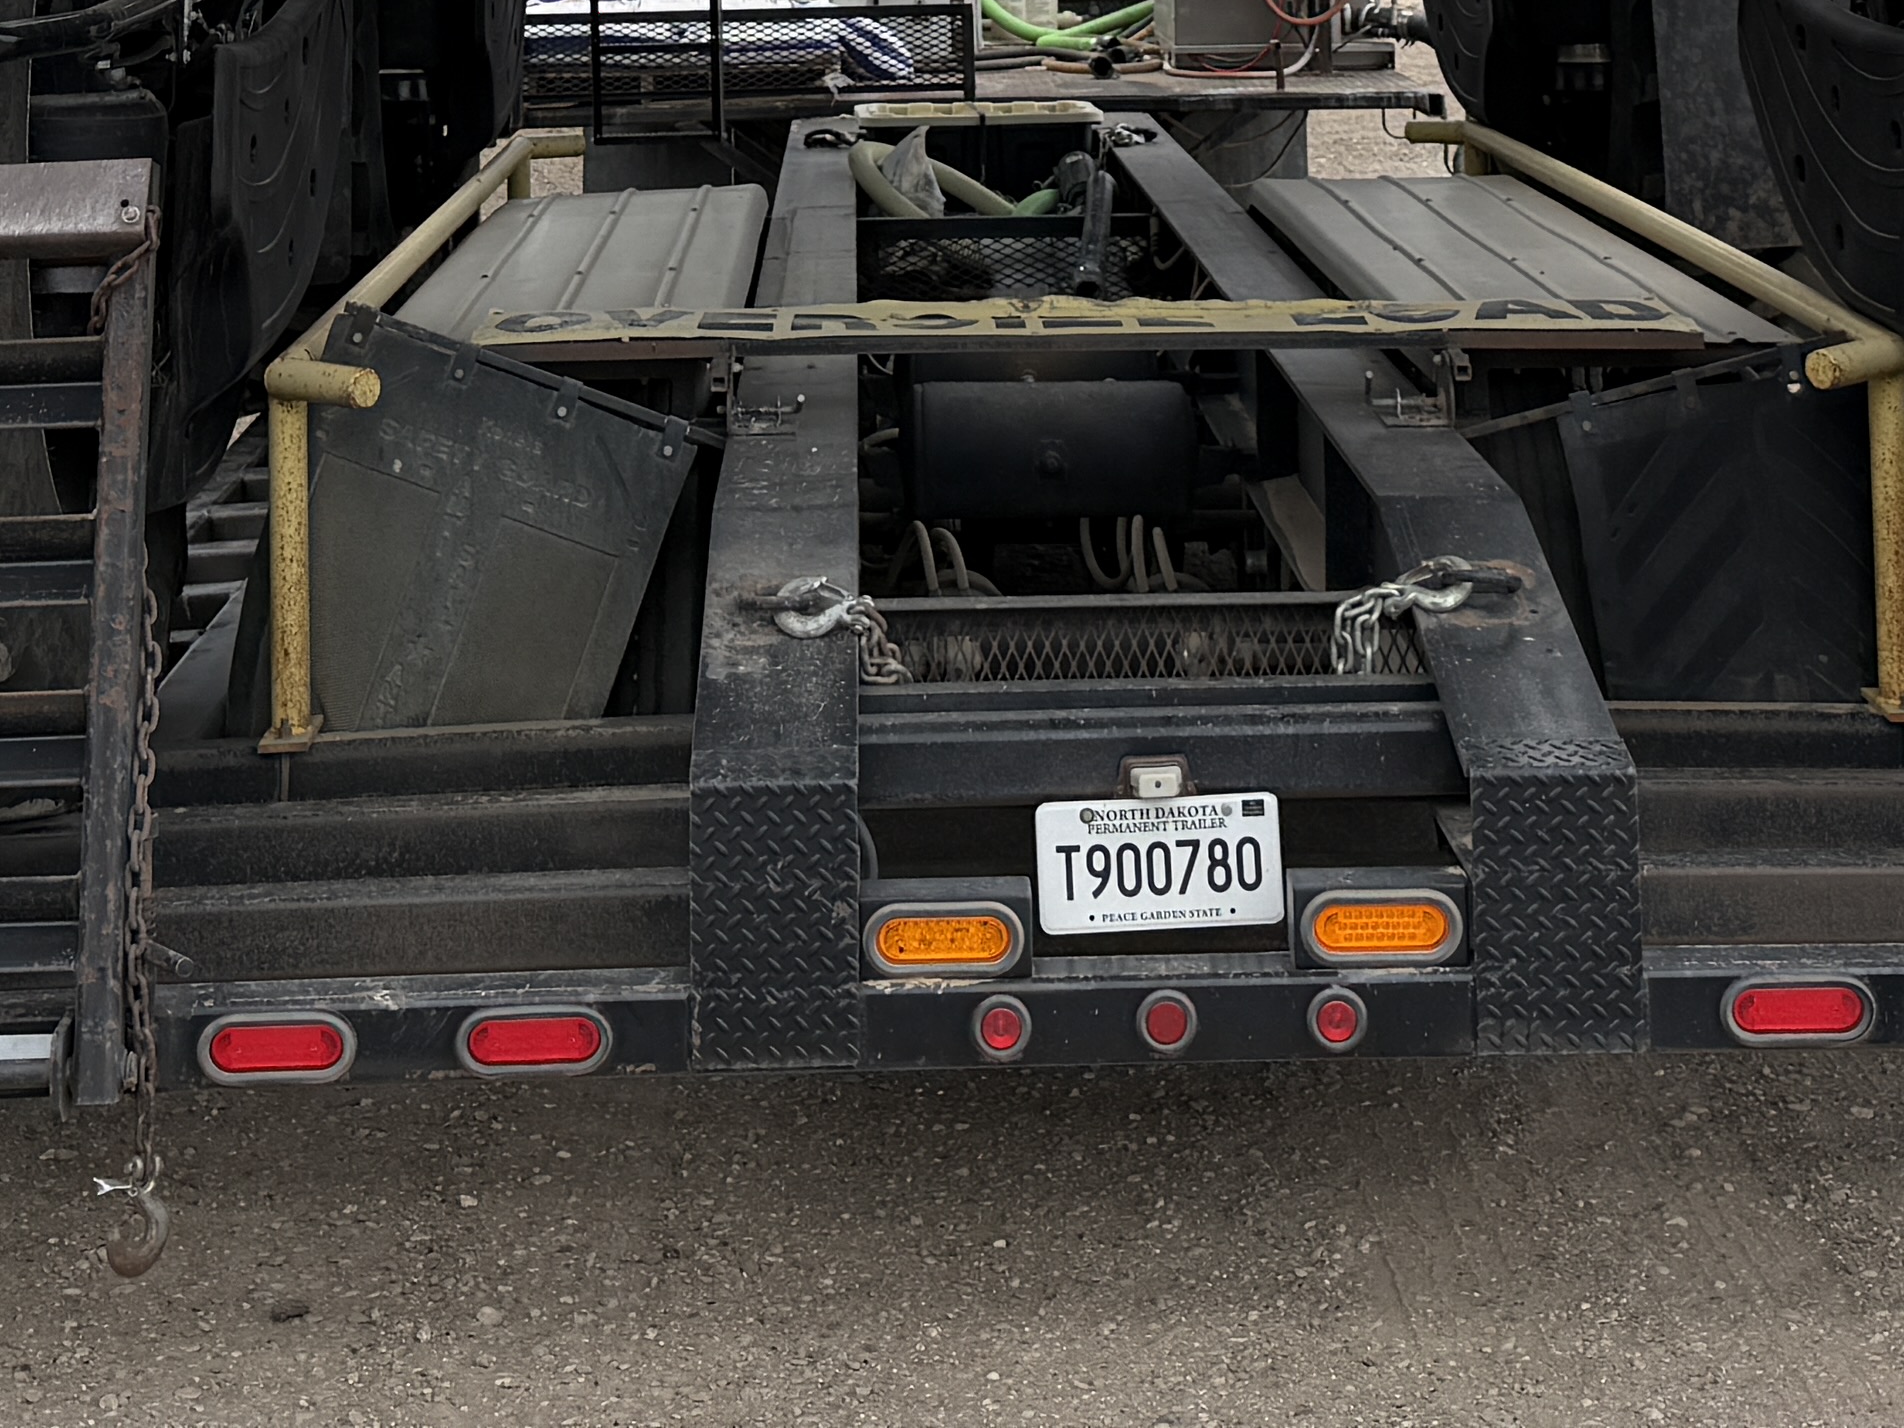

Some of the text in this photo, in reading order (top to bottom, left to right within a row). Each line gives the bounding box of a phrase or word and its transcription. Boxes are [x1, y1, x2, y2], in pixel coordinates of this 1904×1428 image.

[1093, 805, 1218, 821] NORTH DAKOTA
[1088, 817, 1227, 835] PERMANENT TRAILER
[1056, 836, 1262, 901] T900780
[1102, 908, 1222, 922] PEACE GARDEN STATE
